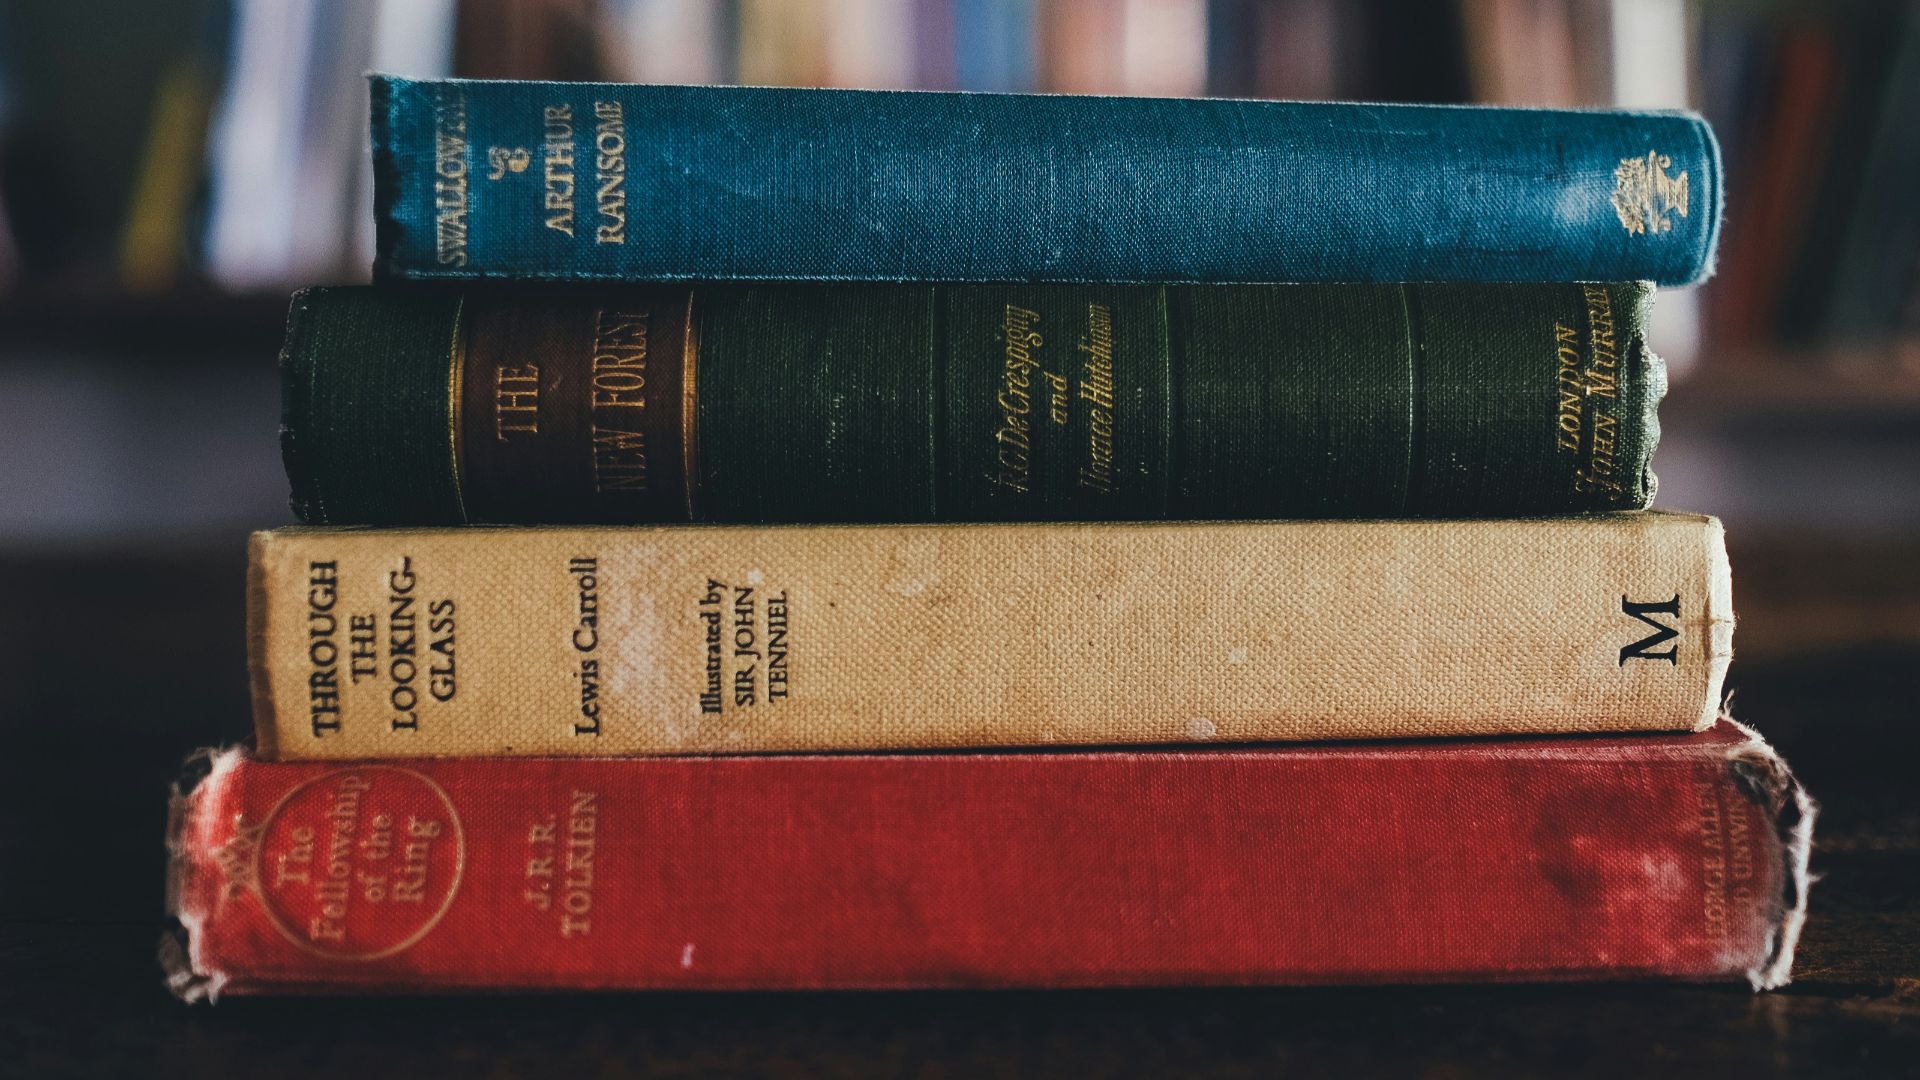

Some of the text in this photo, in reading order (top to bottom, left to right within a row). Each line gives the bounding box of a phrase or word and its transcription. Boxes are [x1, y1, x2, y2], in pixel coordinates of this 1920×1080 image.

[544, 103, 574, 238] ARTHUR
[595, 99, 626, 245] RANSOME
[496, 361, 539, 443] THE
[592, 310, 649, 493] NEW FOREST
[1043, 371, 1068, 425] and
[1078, 301, 1113, 492] Horace Hutchinson
[1553, 321, 1582, 453] LONDON
[308, 560, 341, 738] THROUGH
[351, 614, 377, 685] THE
[389, 556, 418, 732] LOOKING-
[429, 599, 456, 702] GLASS
[570, 557, 600, 737] Lewis Carroll
[700, 578, 728, 714] Illustrated by
[735, 587, 761, 706] SIR JOHN
[768, 591, 788, 703] TENNIEL
[1619, 593, 1680, 667] M
[275, 827, 314, 889] The
[310, 775, 370, 941] Fellowship
[357, 814, 394, 902] of the
[392, 816, 441, 903] Ring
[561, 789, 598, 938] TOLKIEN
